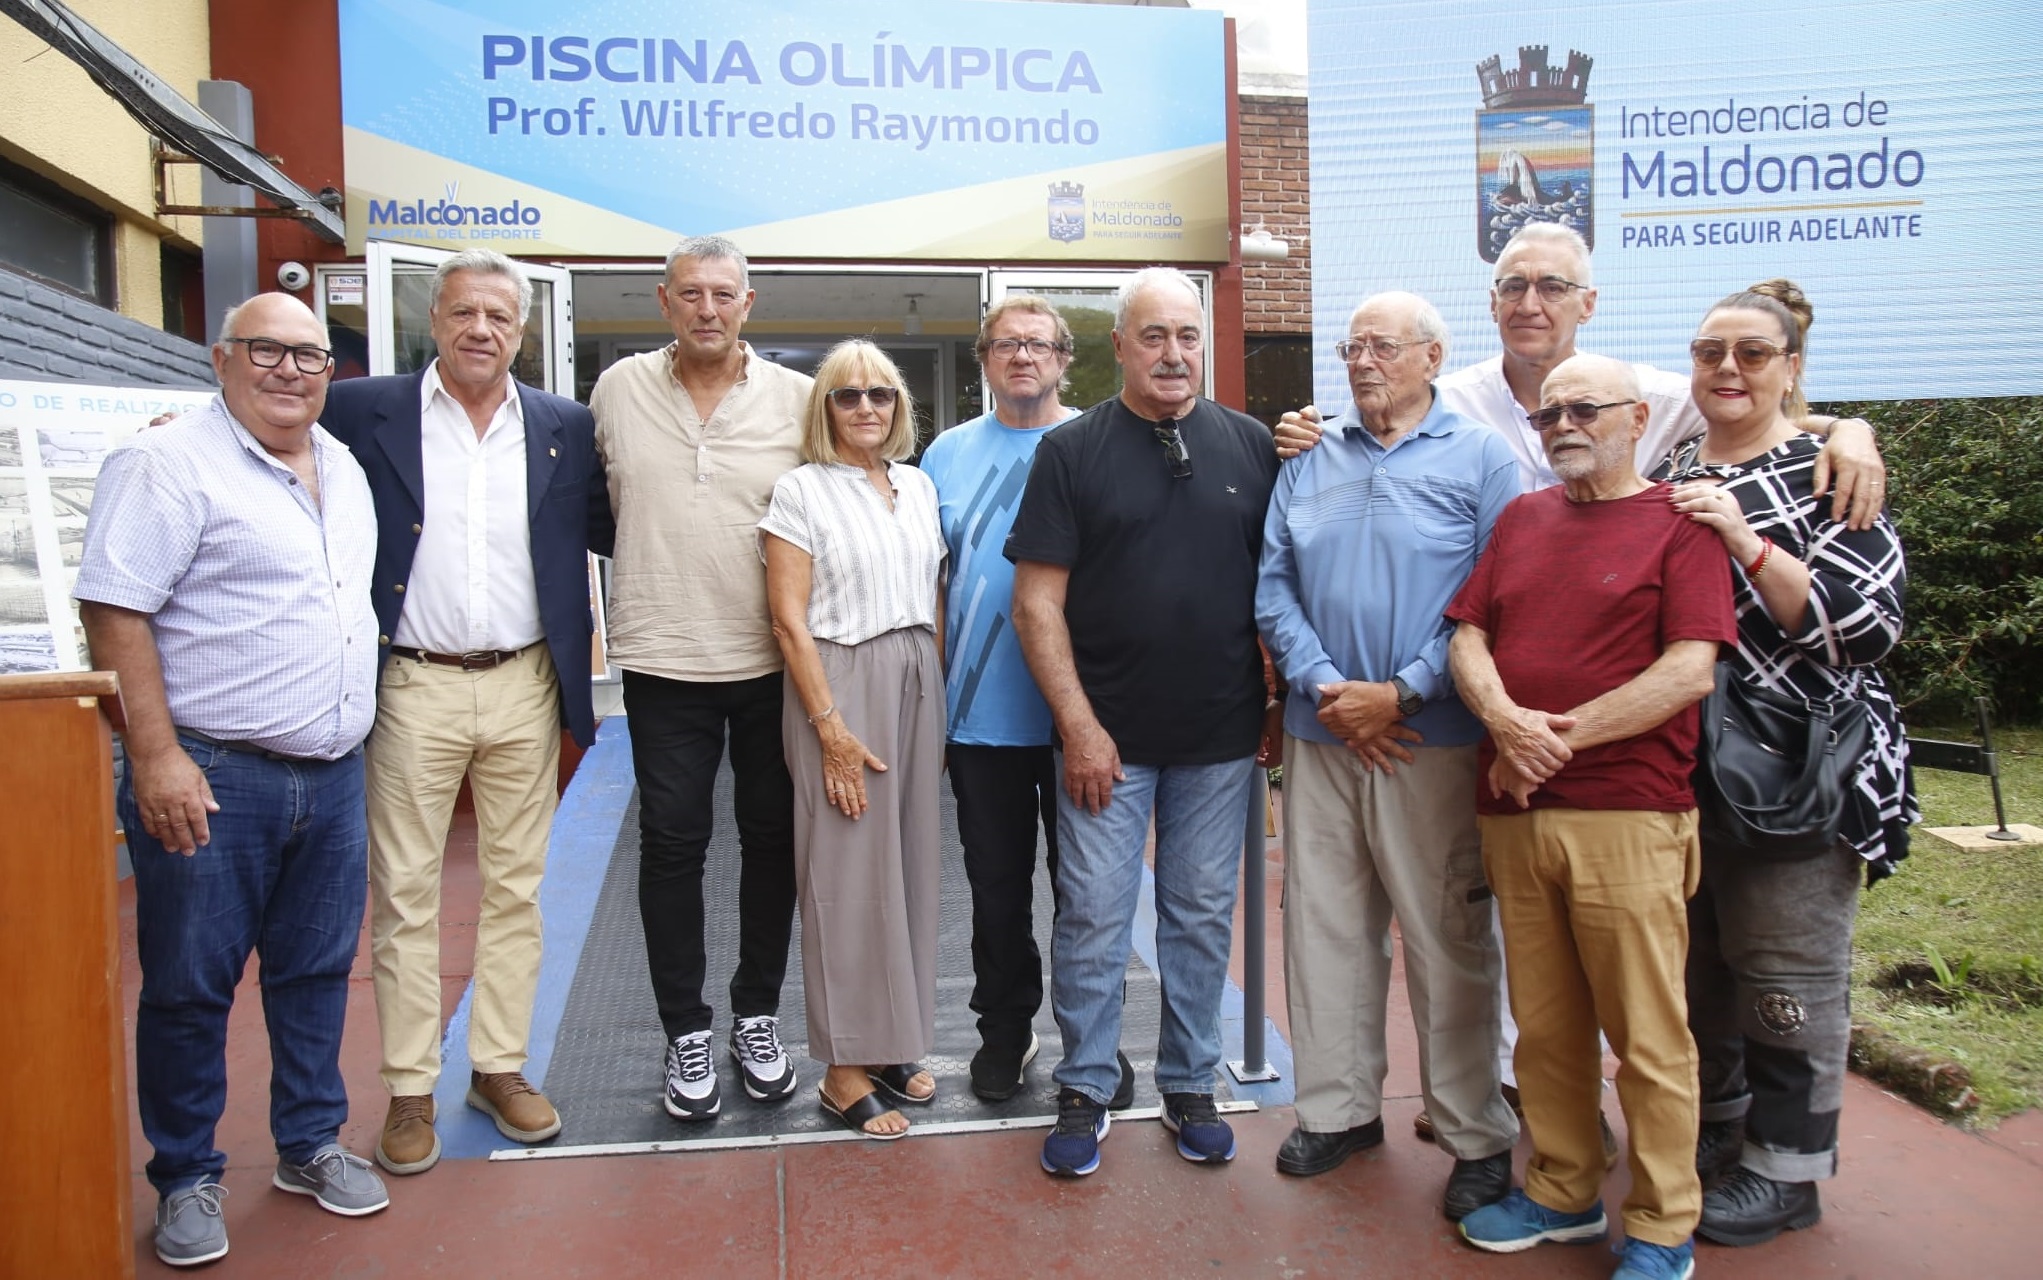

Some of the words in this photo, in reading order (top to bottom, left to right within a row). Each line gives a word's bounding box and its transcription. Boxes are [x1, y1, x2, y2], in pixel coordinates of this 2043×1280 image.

[483, 35, 761, 84] PISCINA
[779, 31, 1103, 94] OLÍMPICA
[488, 97, 606, 136] Prof.
[620, 99, 836, 139] Wilfredo
[851, 103, 1099, 151] Raymondo
[1621, 95, 1831, 138] Intendencia
[1843, 91, 1889, 127] de
[1621, 137, 1925, 199] Maldonado
[369, 199, 541, 226] Maldonado
[1092, 199, 1155, 210] Intendencia
[1157, 200, 1172, 210] de
[1092, 212, 1183, 226] Maldonado
[367, 228, 432, 239] CAPITAL
[437, 229, 468, 240] DEL
[470, 229, 542, 240] DEPORTE
[1621, 224, 1686, 248] PARA
[1692, 220, 1781, 246] SEGUIR
[1788, 215, 1923, 242] ADELANTE
[33, 394, 65, 411] DE
